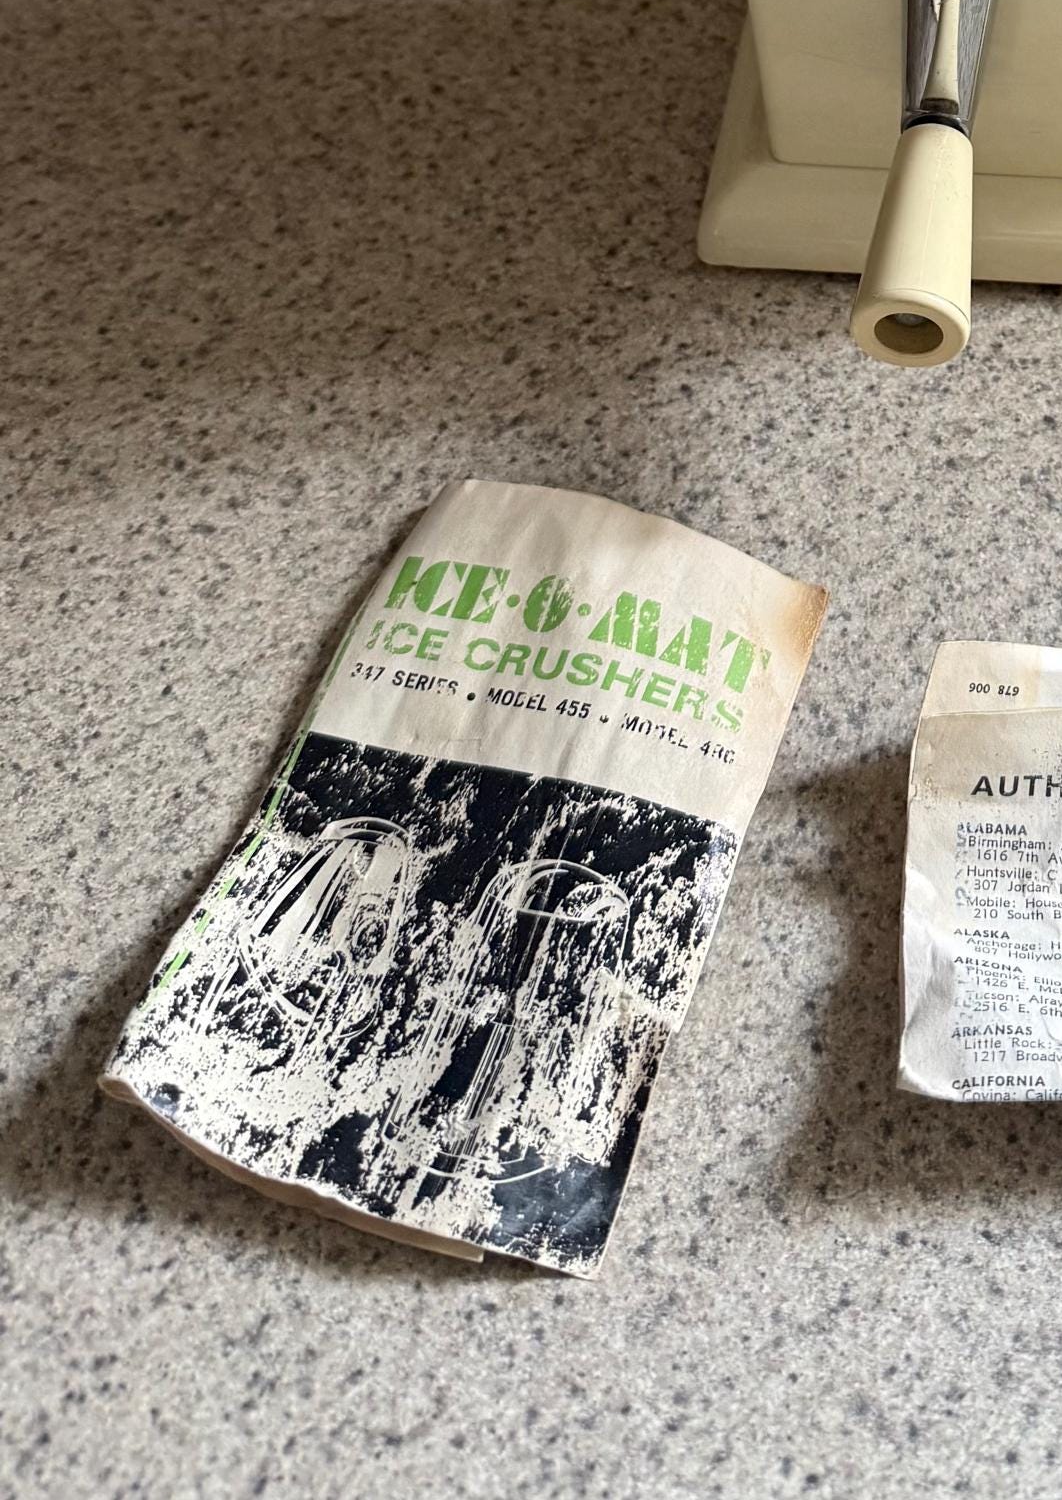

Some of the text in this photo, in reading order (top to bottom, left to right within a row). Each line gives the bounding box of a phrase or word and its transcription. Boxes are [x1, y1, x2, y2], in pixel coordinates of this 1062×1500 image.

[364, 618, 746, 733] ICE CRUSHERS
[392, 670, 459, 696] SERIES
[486, 687, 547, 712] MODEL
[556, 698, 592, 719] 455
[969, 682, 1020, 697] 678 006
[957, 823, 1027, 836] ALABAMA
[968, 836, 1052, 851] Birmingham:
[976, 850, 1008, 862] 1616
[1018, 850, 1039, 863] 7th
[966, 866, 1038, 880] Huntsville:
[1047, 868, 1058, 881] C
[973, 879, 999, 891] 307
[1007, 880, 1050, 894] Jordan
[966, 896, 1016, 908] Mobile:
[973, 908, 998, 920] 210
[1007, 908, 1044, 921] South
[953, 927, 1010, 940] ALASKA
[966, 937, 1042, 952] Anchorage:
[953, 956, 1023, 973] ARIZONA
[966, 966, 1026, 981] Phoenix:
[975, 977, 1008, 988] 1426
[1018, 982, 1029, 990] E.
[973, 1001, 1008, 1012] 2516
[1018, 1003, 1030, 1014] E.
[1040, 1006, 1062, 1018] 6th
[951, 1025, 1033, 1039] ARKANSAS
[964, 1037, 1001, 1050] Little
[1011, 1037, 1052, 1050] Rock:
[973, 1050, 1006, 1062] 1217
[951, 1075, 1046, 1090] CALIFORNIA
